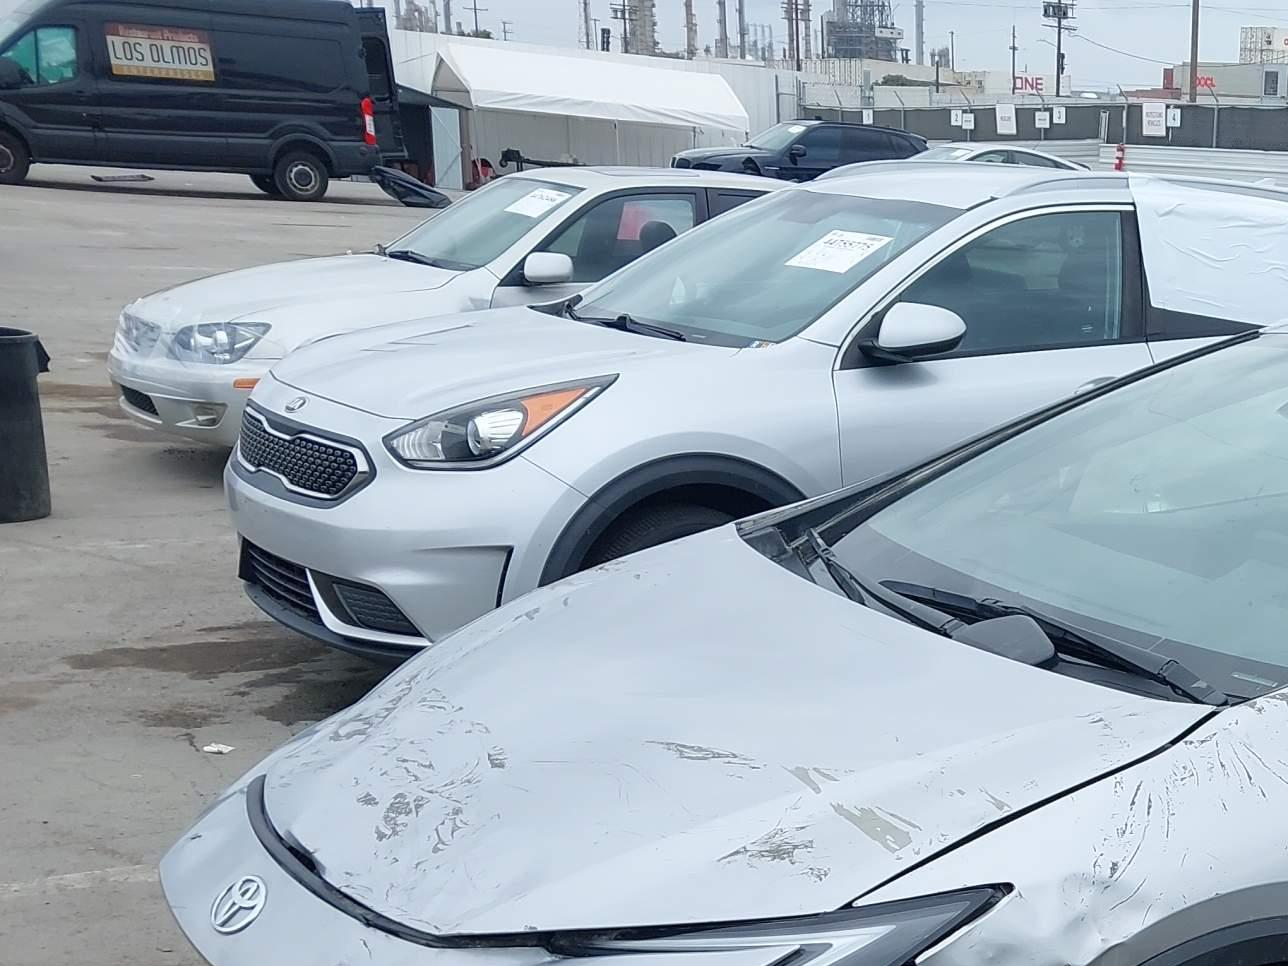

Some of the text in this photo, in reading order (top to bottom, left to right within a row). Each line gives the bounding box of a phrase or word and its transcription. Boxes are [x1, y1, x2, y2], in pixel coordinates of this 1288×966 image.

[111, 40, 208, 66] LOS OLMOS
[1014, 76, 1043, 91] ONE
